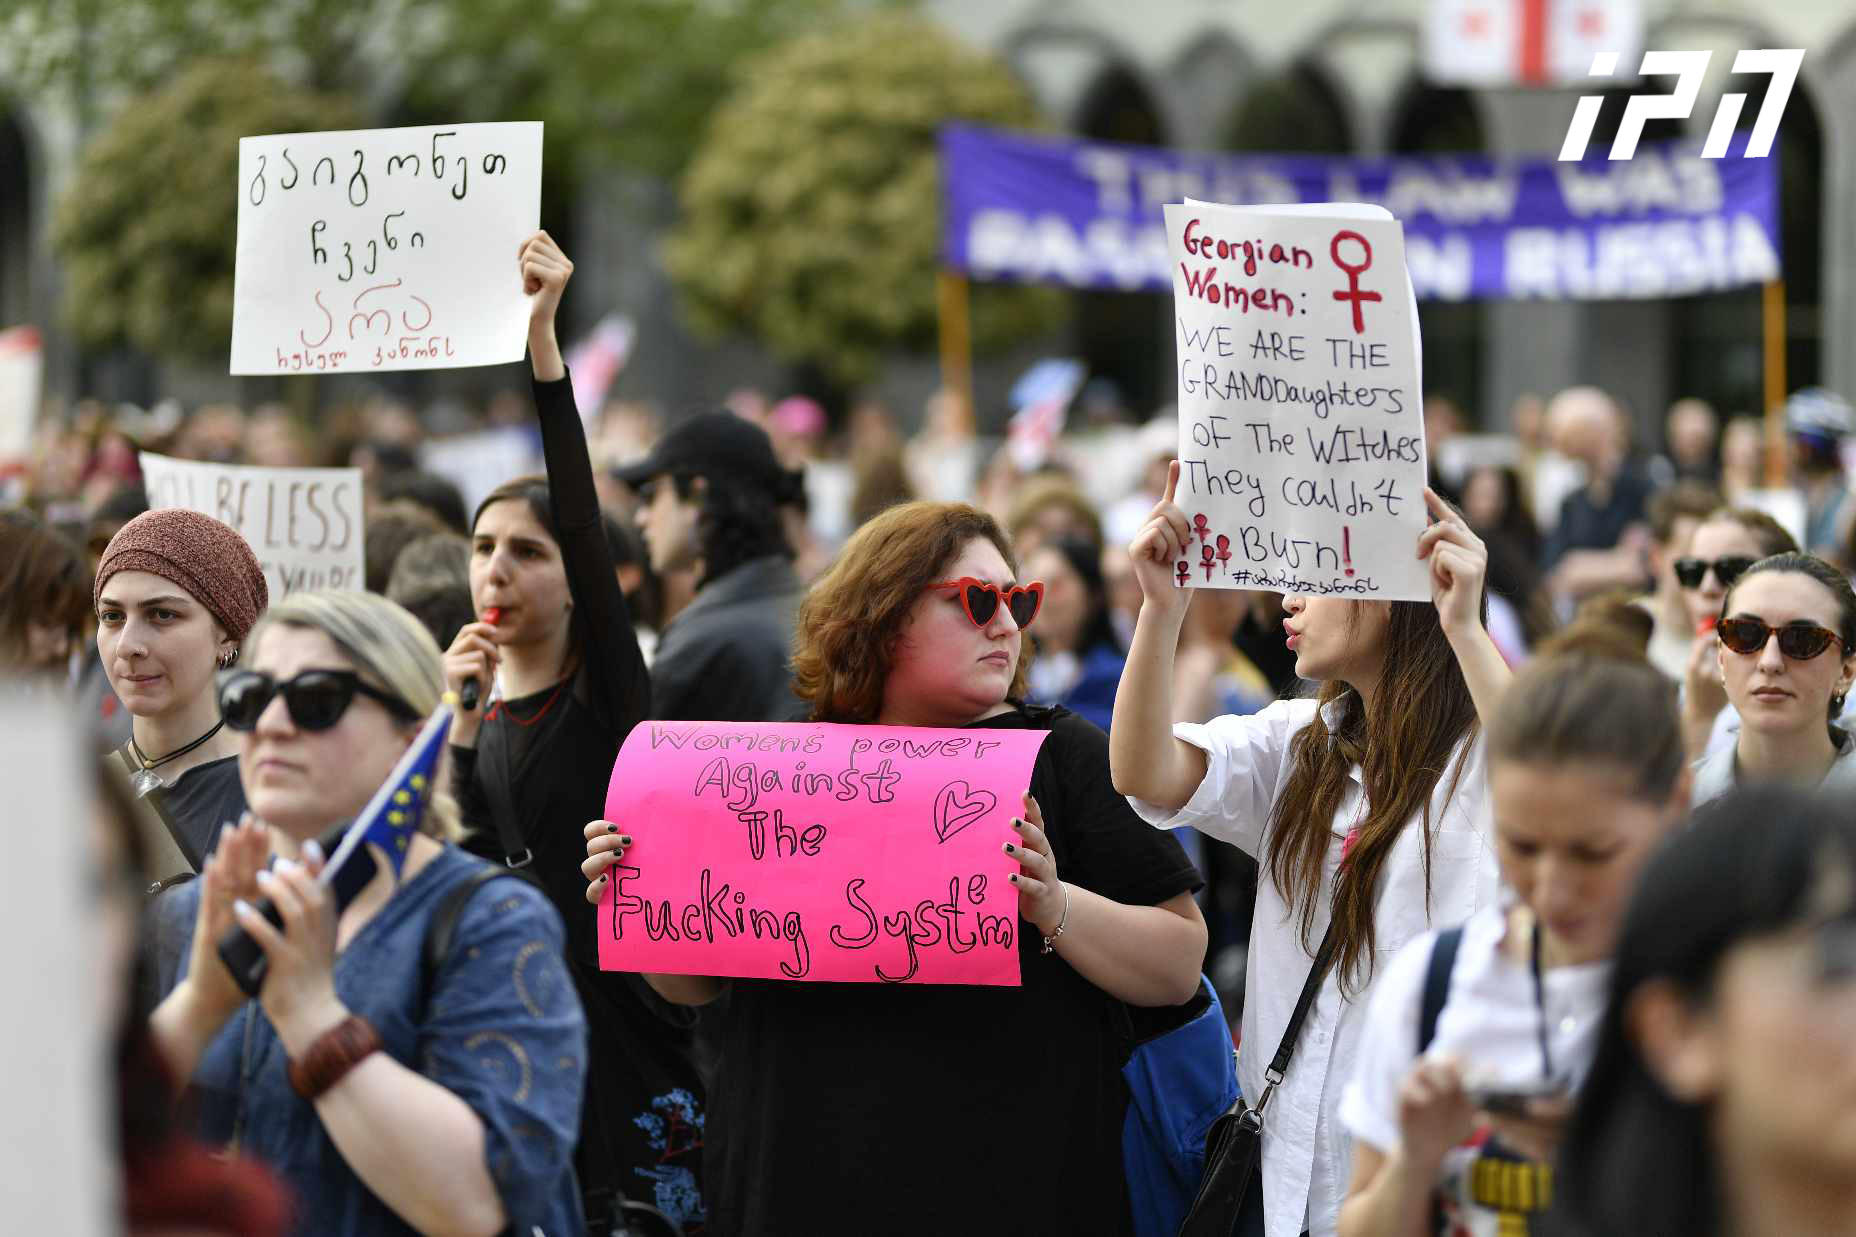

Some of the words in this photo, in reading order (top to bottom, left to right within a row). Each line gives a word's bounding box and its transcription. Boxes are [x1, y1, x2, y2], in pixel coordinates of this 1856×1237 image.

[250, 132, 506, 206] გაიგონეთ
[310, 209, 425, 282] ჩვენი
[1183, 218, 1313, 277] Georgian
[300, 278, 433, 348] არა
[1181, 262, 1307, 317] Women:
[1179, 317, 1234, 357] WE
[1250, 329, 1306, 361] ARE
[1325, 338, 1390, 370] THE
[265, 481, 353, 553] LESS
[1184, 459, 1266, 518] They
[849, 737, 1001, 771] power
[694, 756, 902, 812] Against
[738, 808, 827, 861] The
